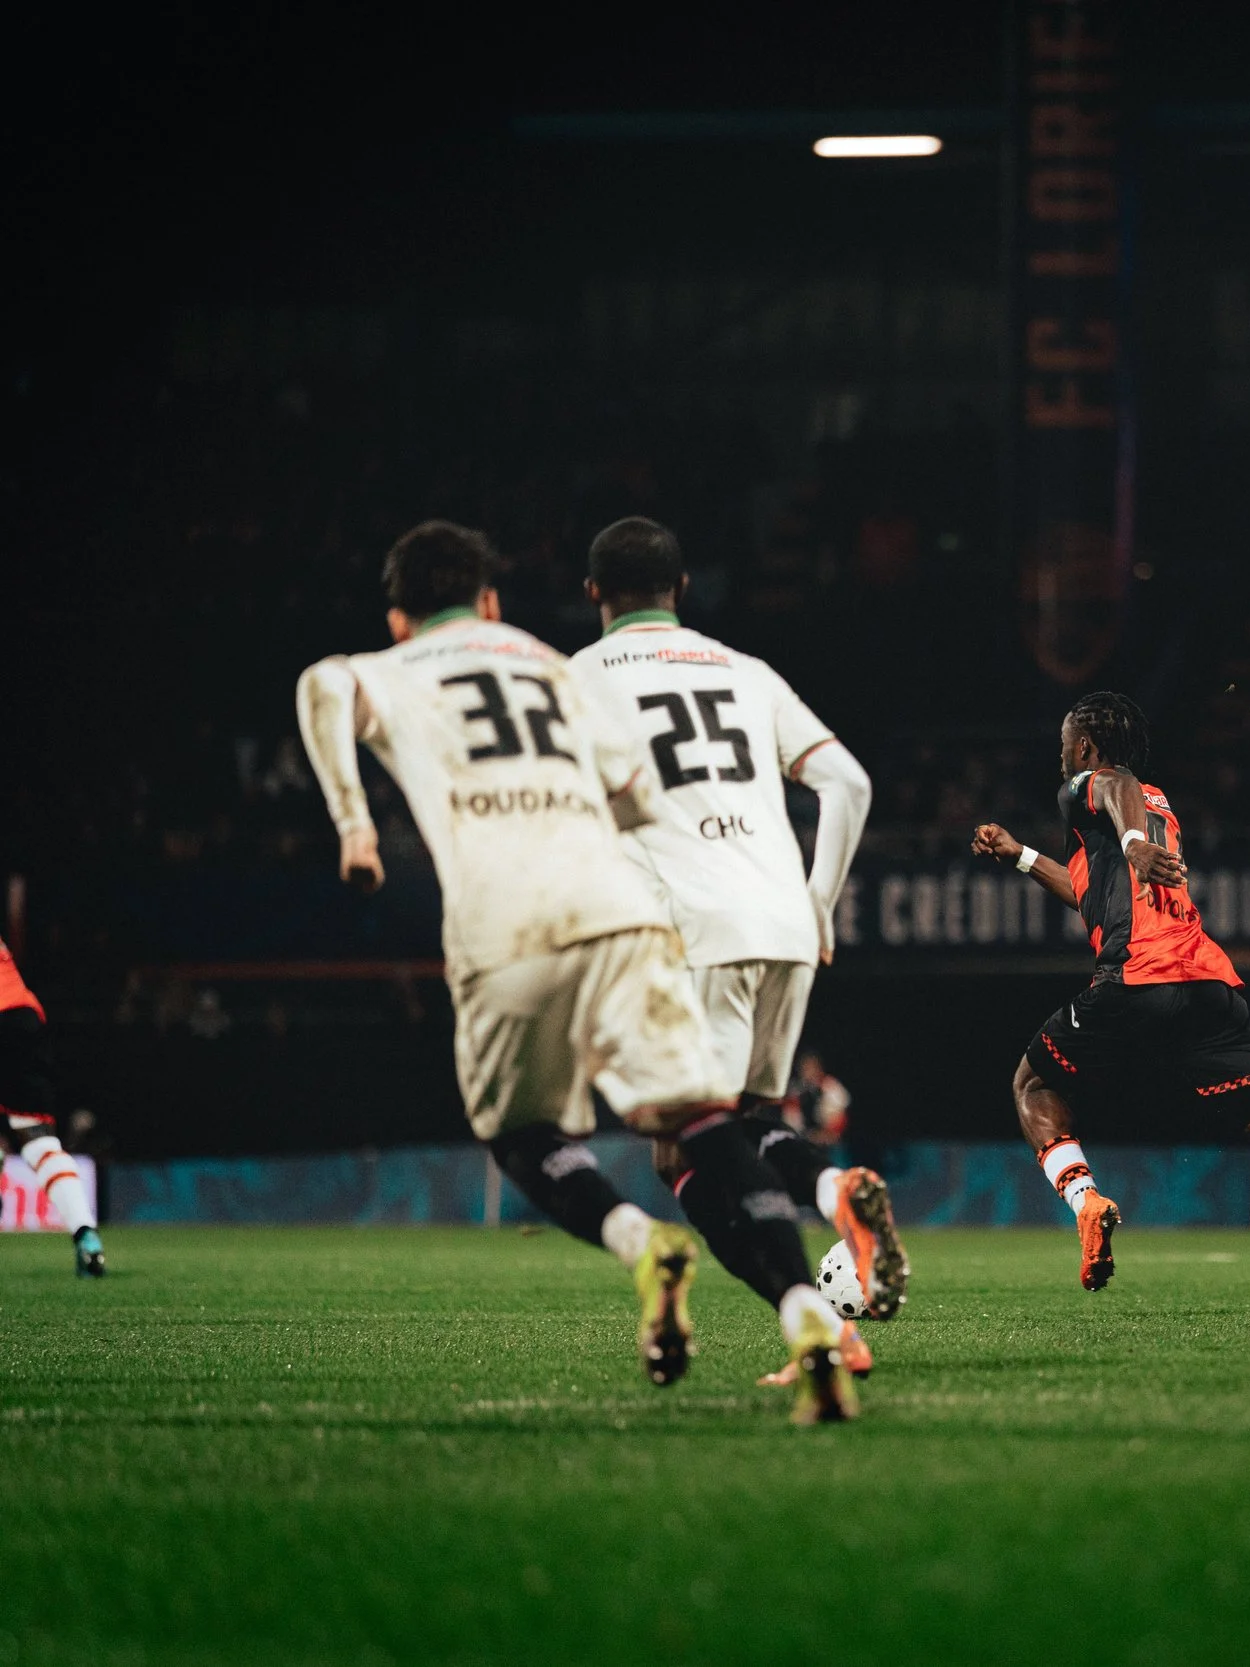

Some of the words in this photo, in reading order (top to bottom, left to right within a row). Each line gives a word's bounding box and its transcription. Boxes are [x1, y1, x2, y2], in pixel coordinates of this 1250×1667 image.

[1025, 0, 1118, 276] LORIE
[441, 671, 578, 762] 32
[637, 690, 756, 790] 25
